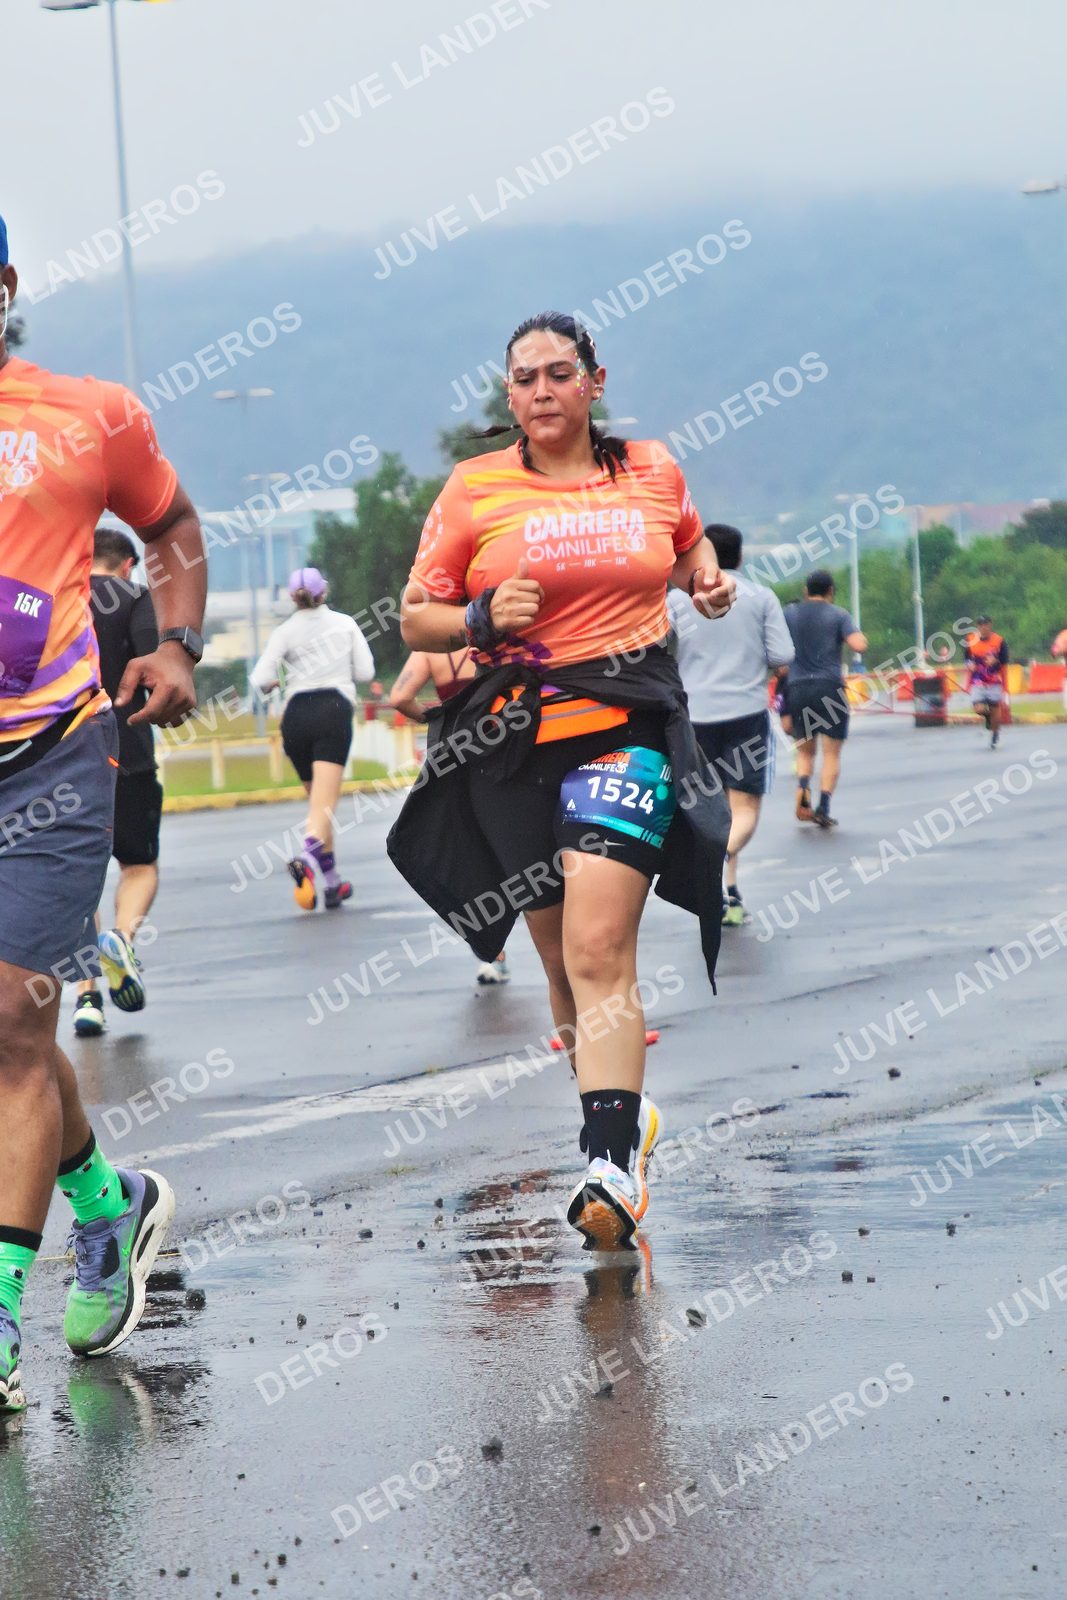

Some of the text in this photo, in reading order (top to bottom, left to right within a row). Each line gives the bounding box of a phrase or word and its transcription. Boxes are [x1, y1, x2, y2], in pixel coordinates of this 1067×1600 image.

[524, 508, 645, 545] CARRERA
[526, 536, 624, 562] OMNILIFE
[556, 562, 566, 572] 5K
[584, 558, 597, 568] 10K
[14, 591, 43, 618] 15K
[592, 752, 631, 764] RERA
[659, 763, 673, 782] 10
[587, 776, 654, 814] 1524
